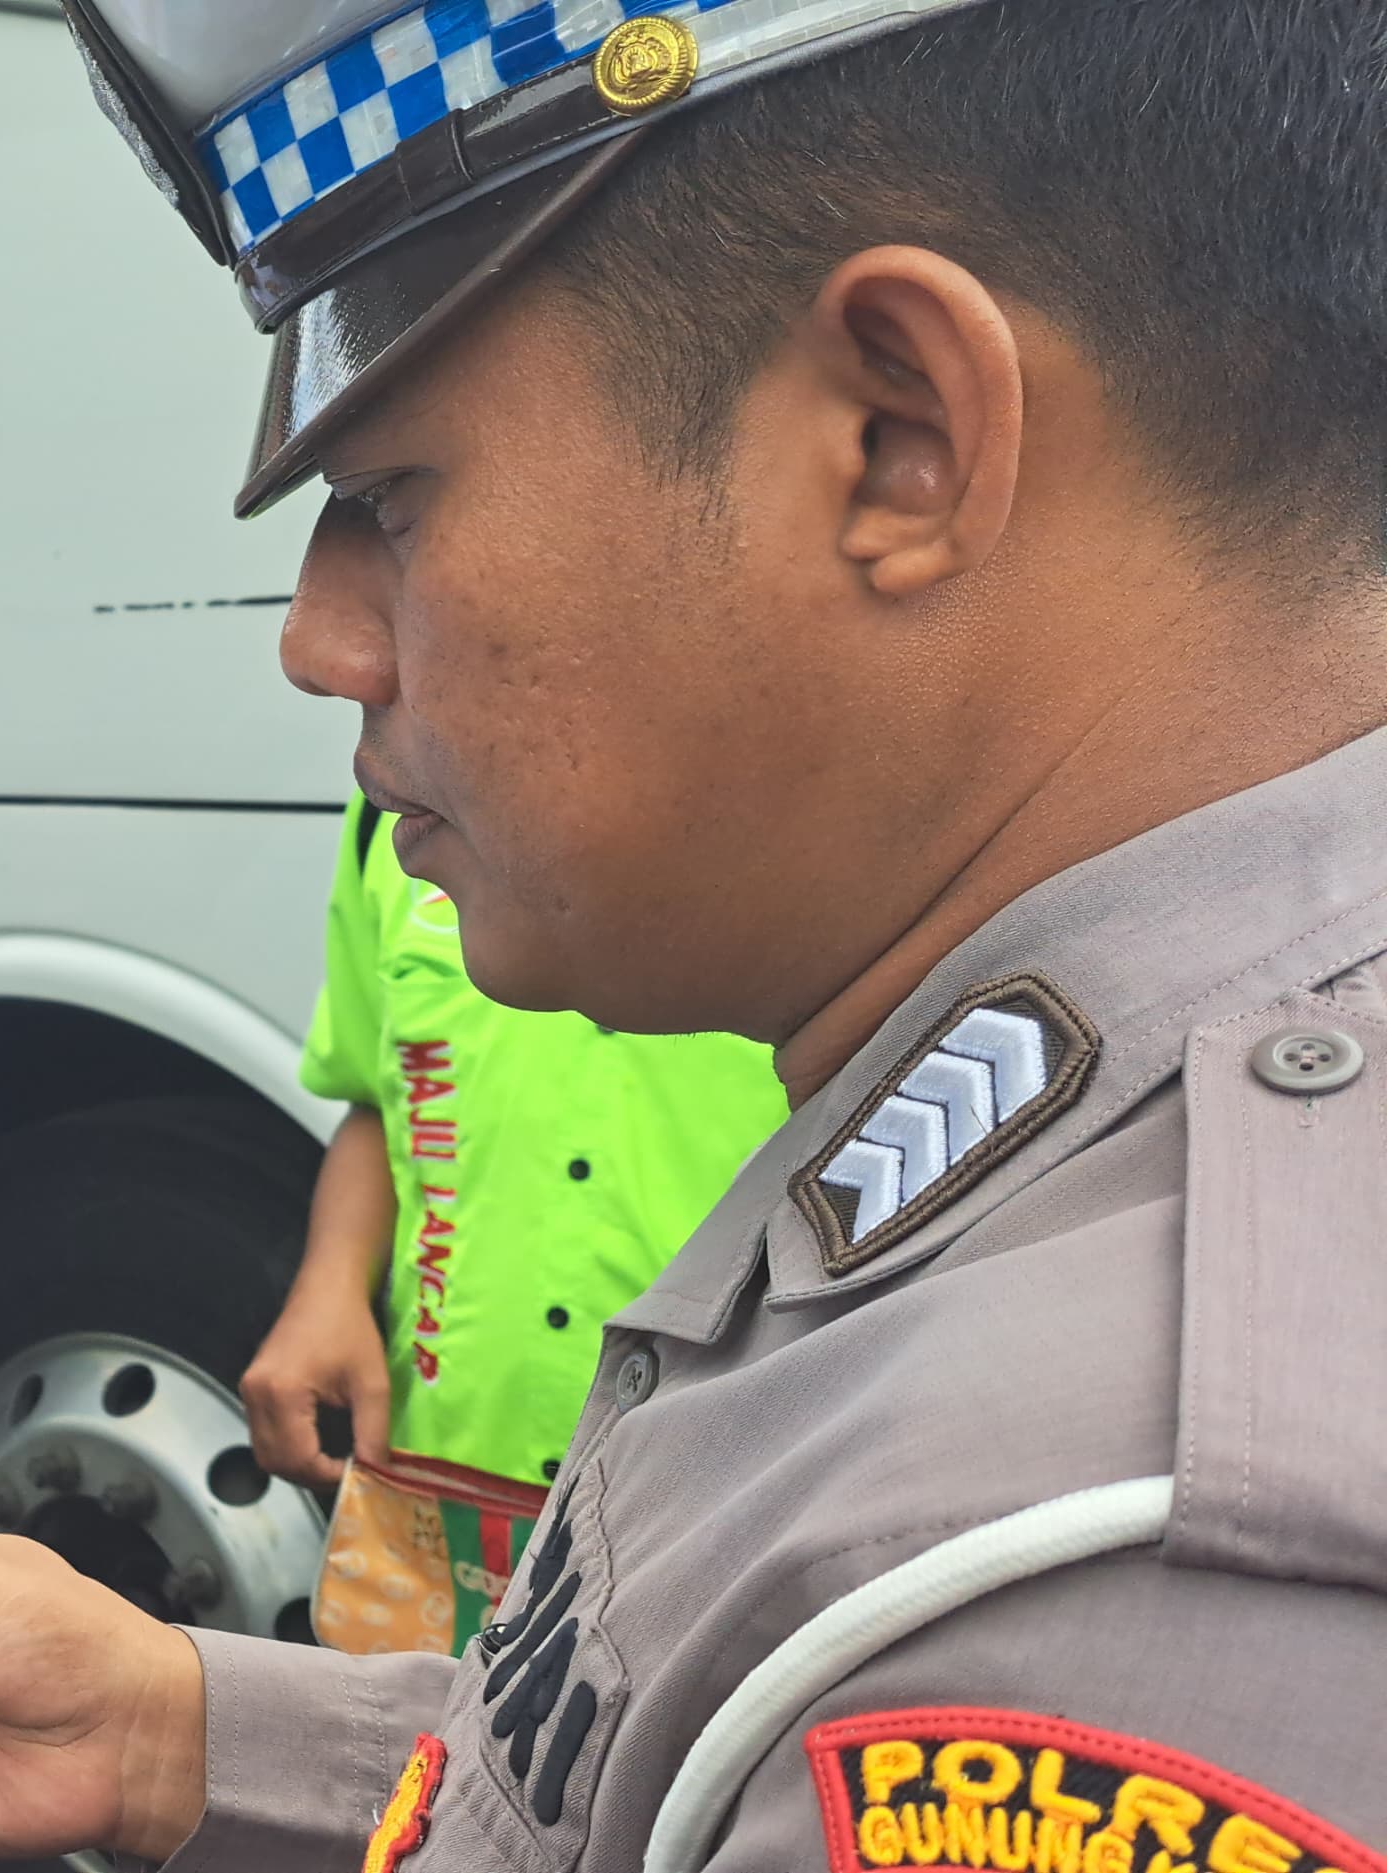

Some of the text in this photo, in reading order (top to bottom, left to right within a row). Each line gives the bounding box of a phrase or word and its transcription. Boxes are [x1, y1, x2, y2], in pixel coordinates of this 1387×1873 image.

[397, 1039, 457, 1385] MAJU LANCAR
[860, 1739, 1352, 1873] POLRE
